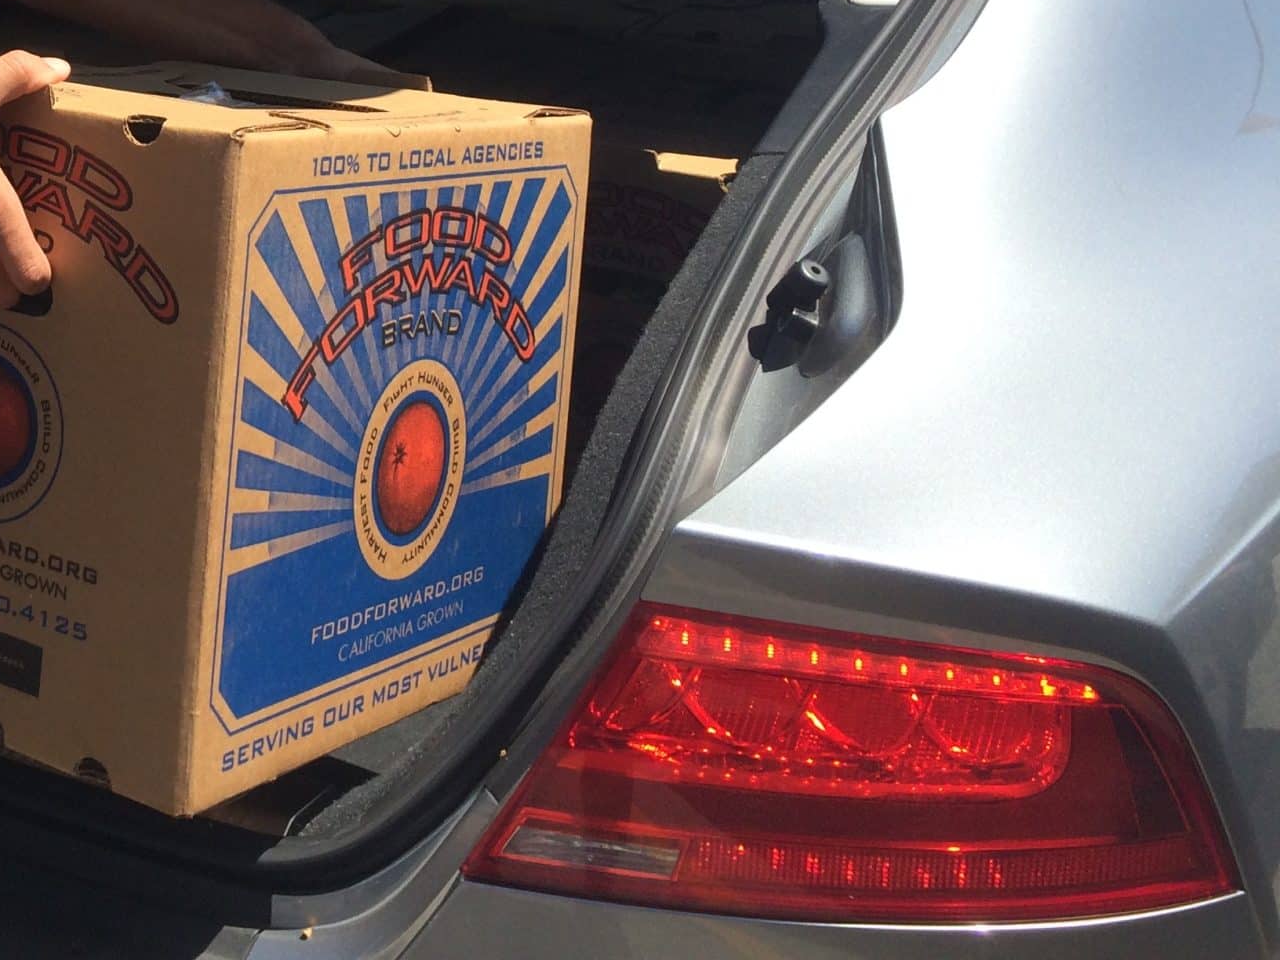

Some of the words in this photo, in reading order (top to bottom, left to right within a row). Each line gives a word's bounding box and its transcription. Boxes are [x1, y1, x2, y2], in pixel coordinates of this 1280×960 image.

[312, 153, 360, 176] 100%
[367, 152, 391, 172] TO
[399, 147, 456, 170] LOCAL
[461, 141, 544, 164] AGENCIES
[338, 207, 512, 293] FOOD
[281, 252, 536, 425] FORWARD
[381, 308, 463, 348] BRAND
[359, 427, 379, 485] FOOD
[451, 418, 461, 475] BUILD
[359, 494, 388, 564] HARVEST
[0, 564, 68, 601] GROWN
[310, 565, 484, 645] FOODFORWARD.ORG
[337, 620, 413, 662] CALIFORNIA
[416, 600, 464, 632] GROWN
[221, 716, 315, 772] SERVING
[322, 694, 365, 728] OUR
[371, 670, 424, 708] MOST
